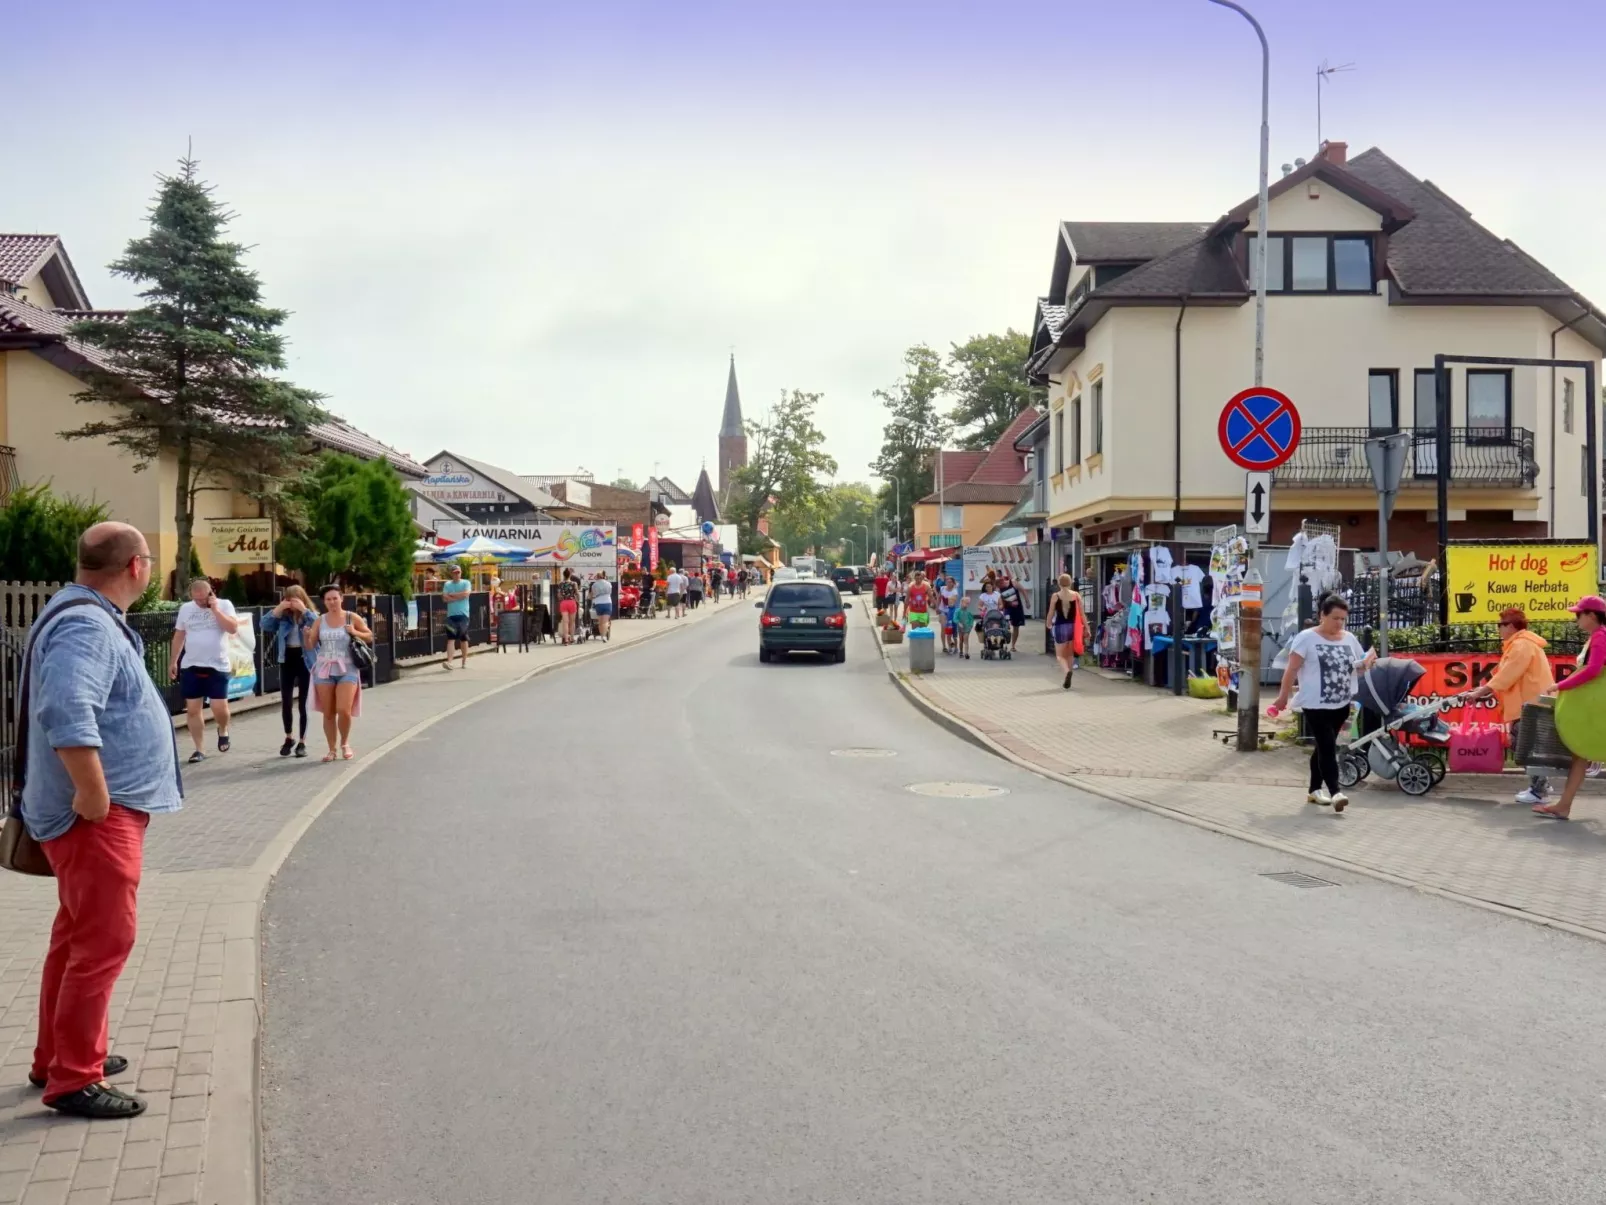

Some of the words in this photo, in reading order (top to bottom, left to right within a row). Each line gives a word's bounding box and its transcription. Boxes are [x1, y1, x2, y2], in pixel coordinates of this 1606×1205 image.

[211, 526, 236, 534] Pokoje
[462, 528, 542, 540] KAWIARNIA
[227, 534, 270, 553] Ada
[1488, 553, 1516, 571] Hot
[1520, 552, 1549, 576] dog
[1487, 580, 1517, 594] Kawa
[1524, 579, 1569, 593] Herbata
[1529, 597, 1582, 611] Czekola
[1444, 661, 1578, 688] SKP
[1457, 748, 1490, 757] ONLY
